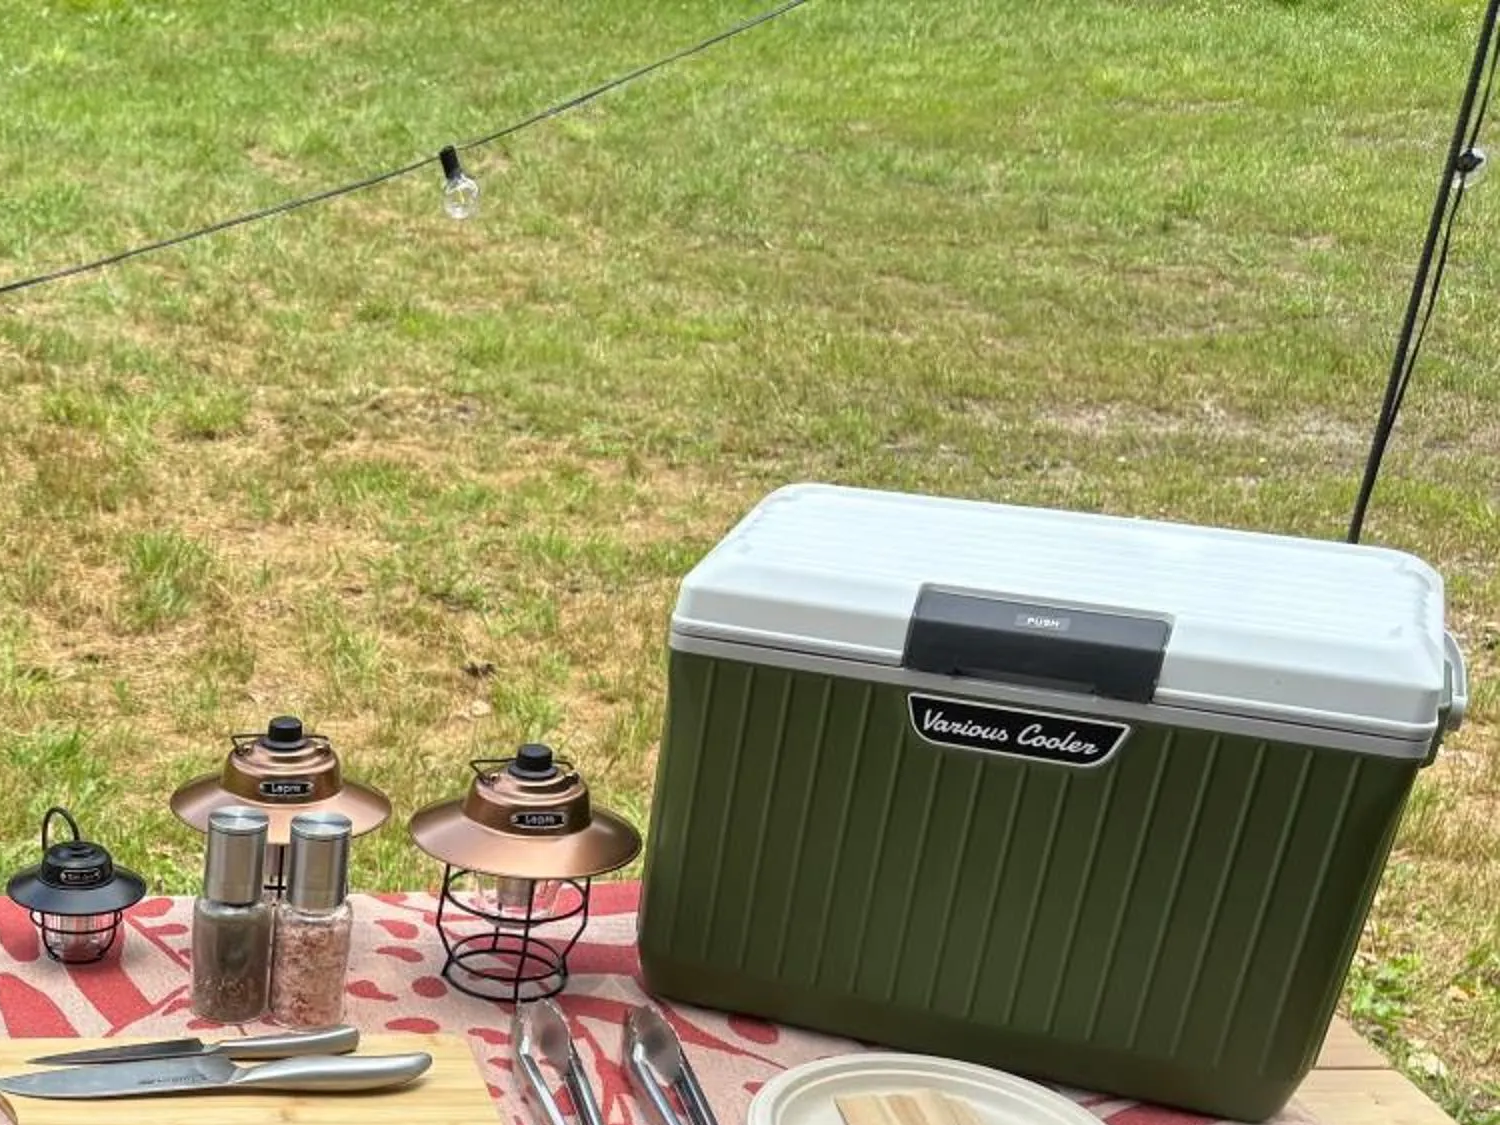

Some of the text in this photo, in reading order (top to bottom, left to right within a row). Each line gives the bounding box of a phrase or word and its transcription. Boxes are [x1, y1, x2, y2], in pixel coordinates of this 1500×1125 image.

[1027, 616, 1060, 629] PUSH
[922, 708, 1099, 755] Various Cooler
